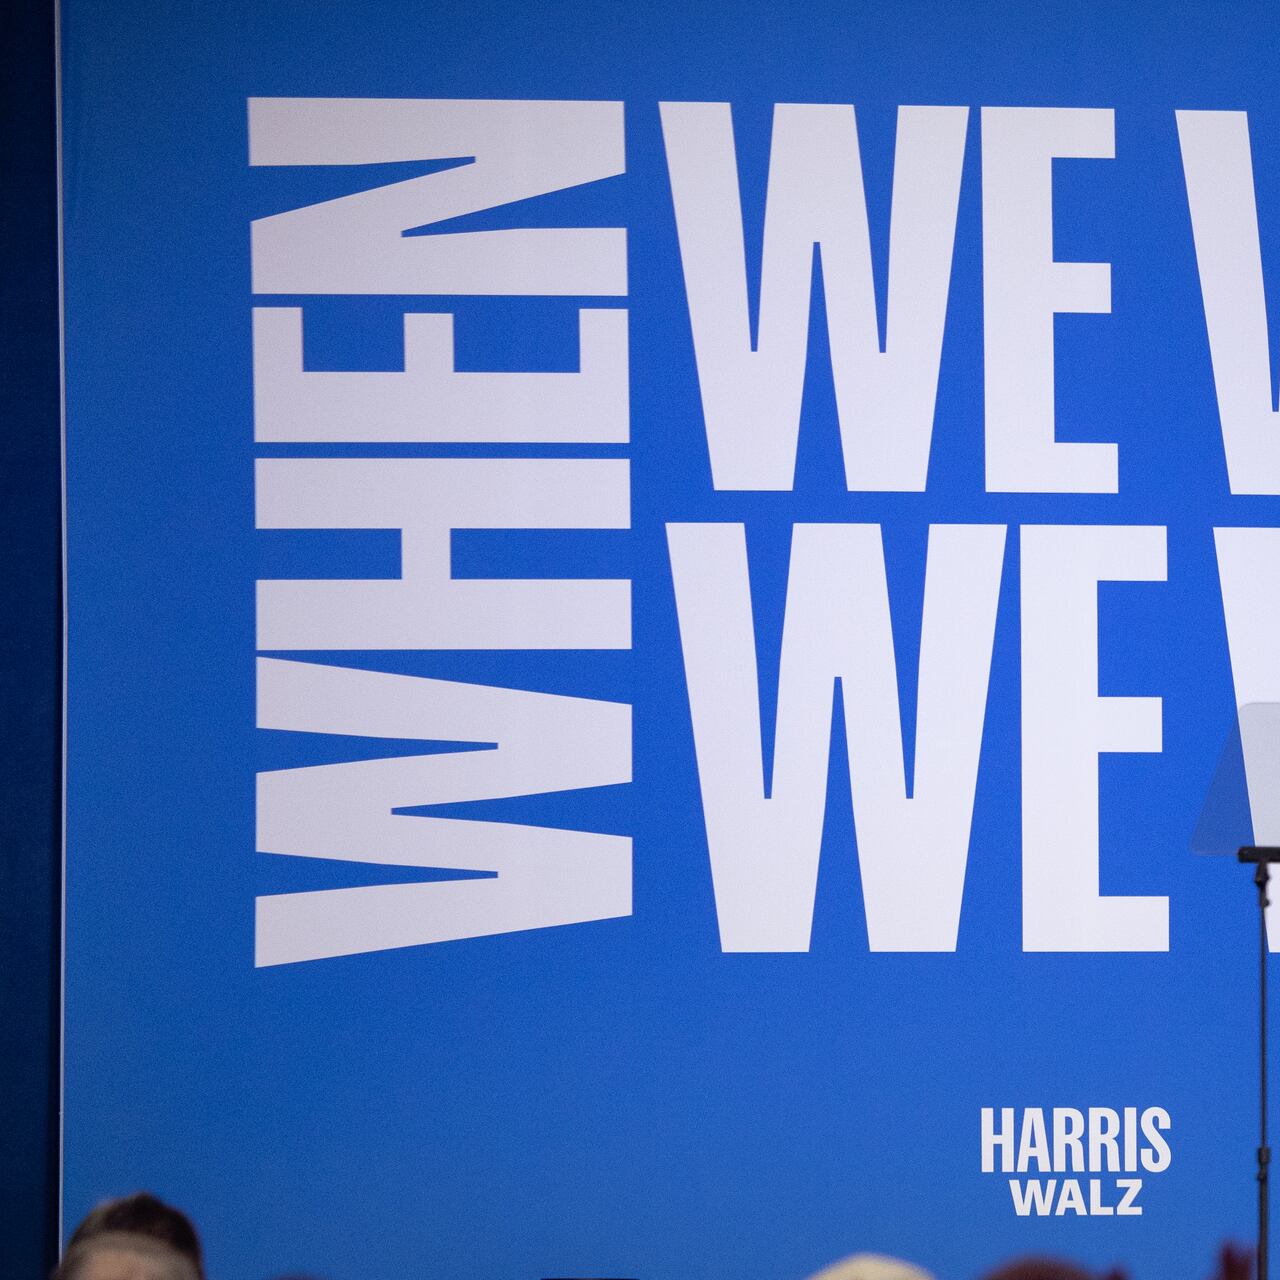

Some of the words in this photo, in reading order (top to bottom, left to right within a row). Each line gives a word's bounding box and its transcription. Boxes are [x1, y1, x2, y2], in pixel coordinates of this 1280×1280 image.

[659, 101, 1119, 494] WE
[248, 97, 633, 968] WHEN
[665, 522, 1170, 953] WE
[980, 1106, 1172, 1173] HARRIS
[1008, 1178, 1143, 1217] WALZ
